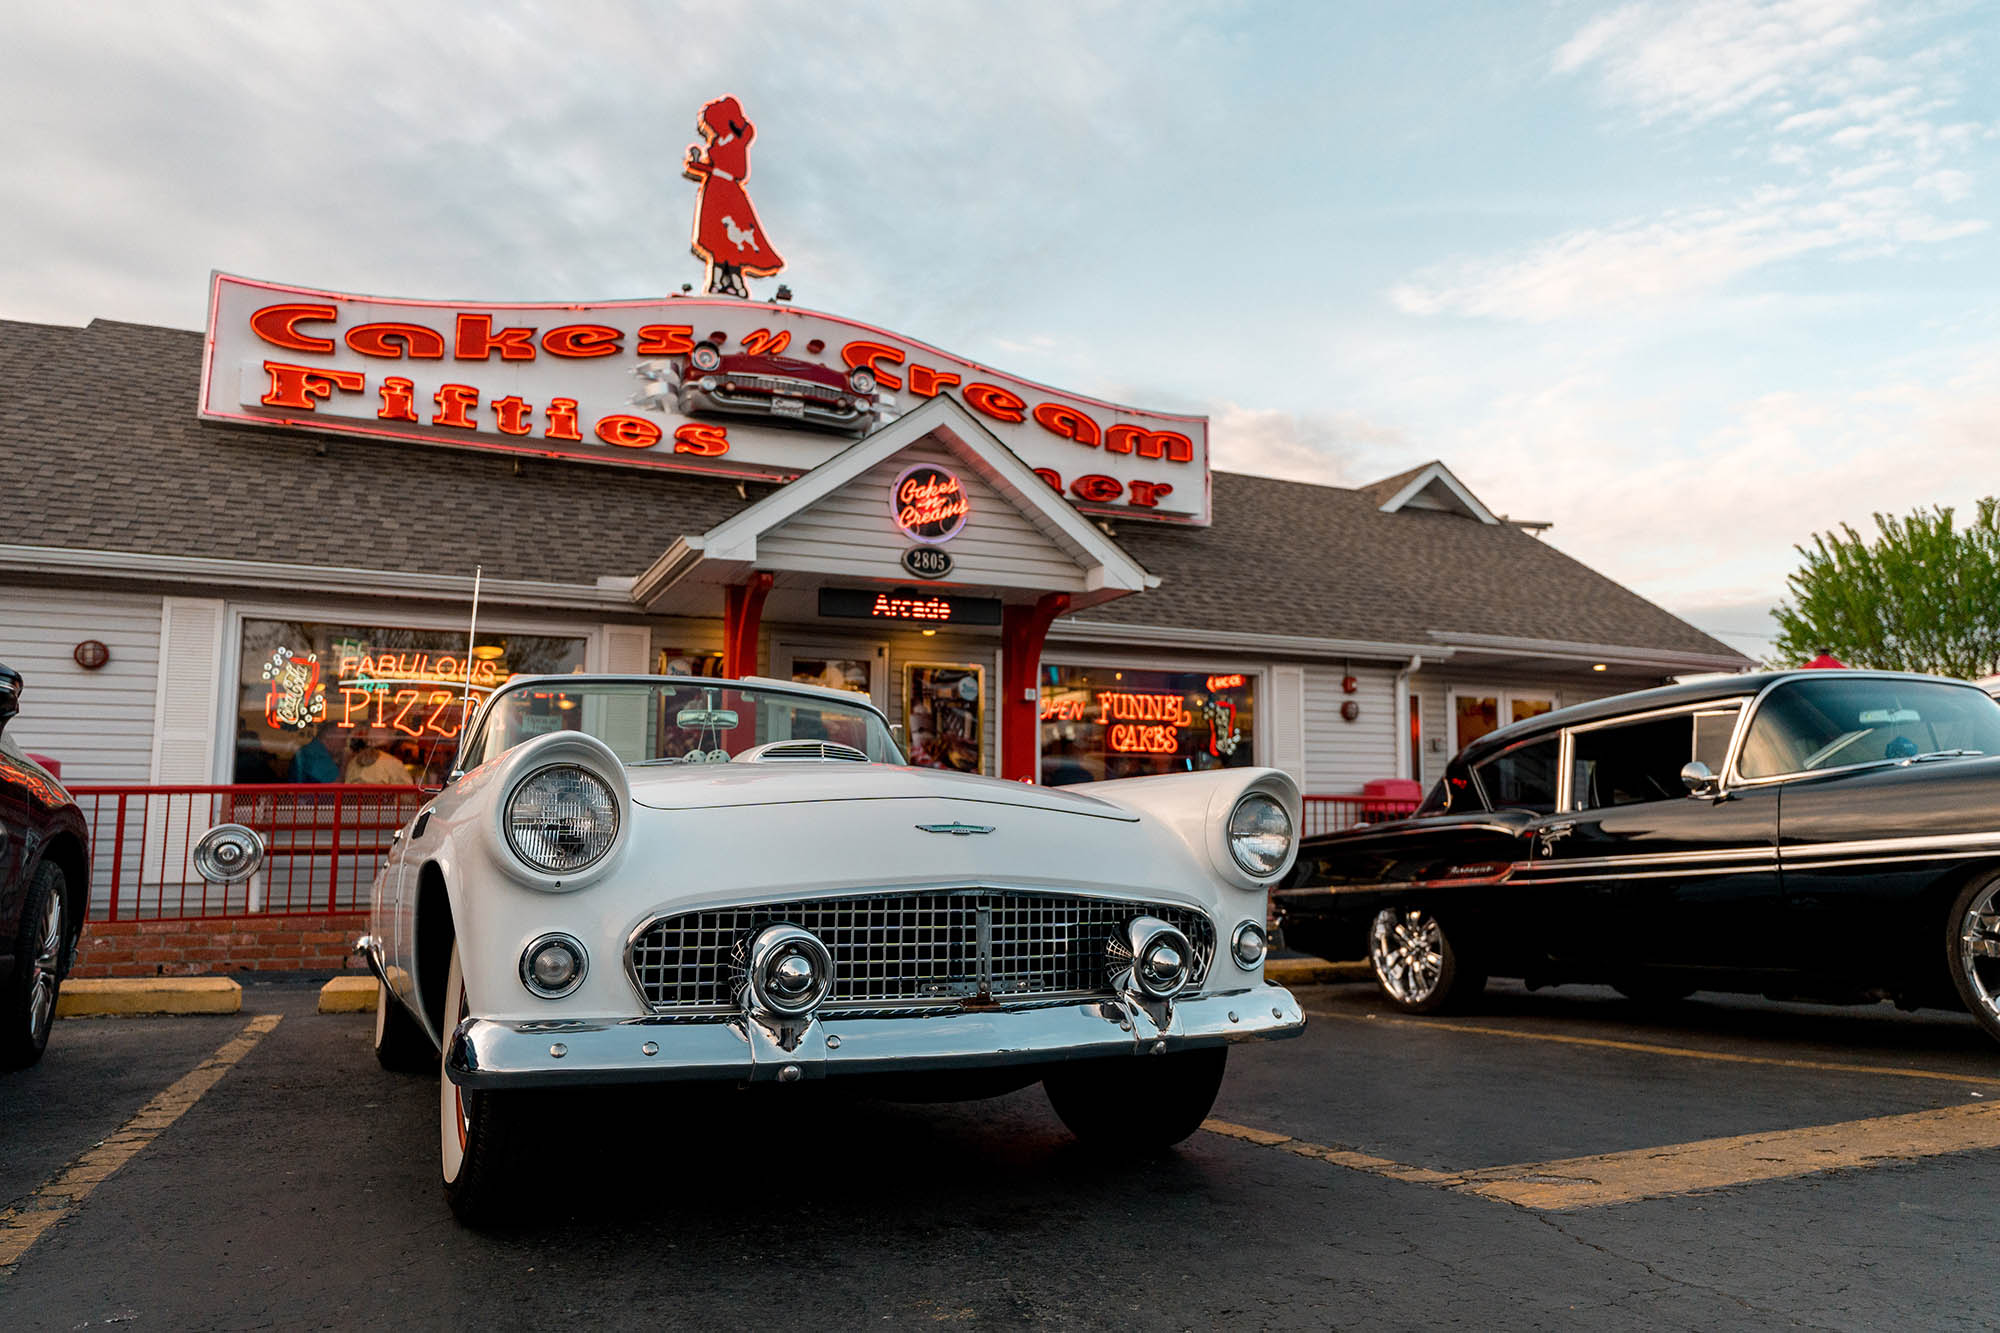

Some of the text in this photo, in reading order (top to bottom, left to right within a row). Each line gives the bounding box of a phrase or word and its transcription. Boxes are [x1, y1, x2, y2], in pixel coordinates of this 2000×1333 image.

[250, 304, 693, 359] Cakes
[841, 340, 1193, 461] Cream
[262, 360, 729, 457] Fifties
[901, 474, 959, 503] Cakes
[899, 499, 969, 528] Creams
[914, 551, 945, 570] 2805
[872, 594, 951, 619] Arcade
[338, 654, 497, 683] FABULOUS
[1095, 692, 1192, 727] FUNNEL
[1111, 724, 1178, 753] CAKES
